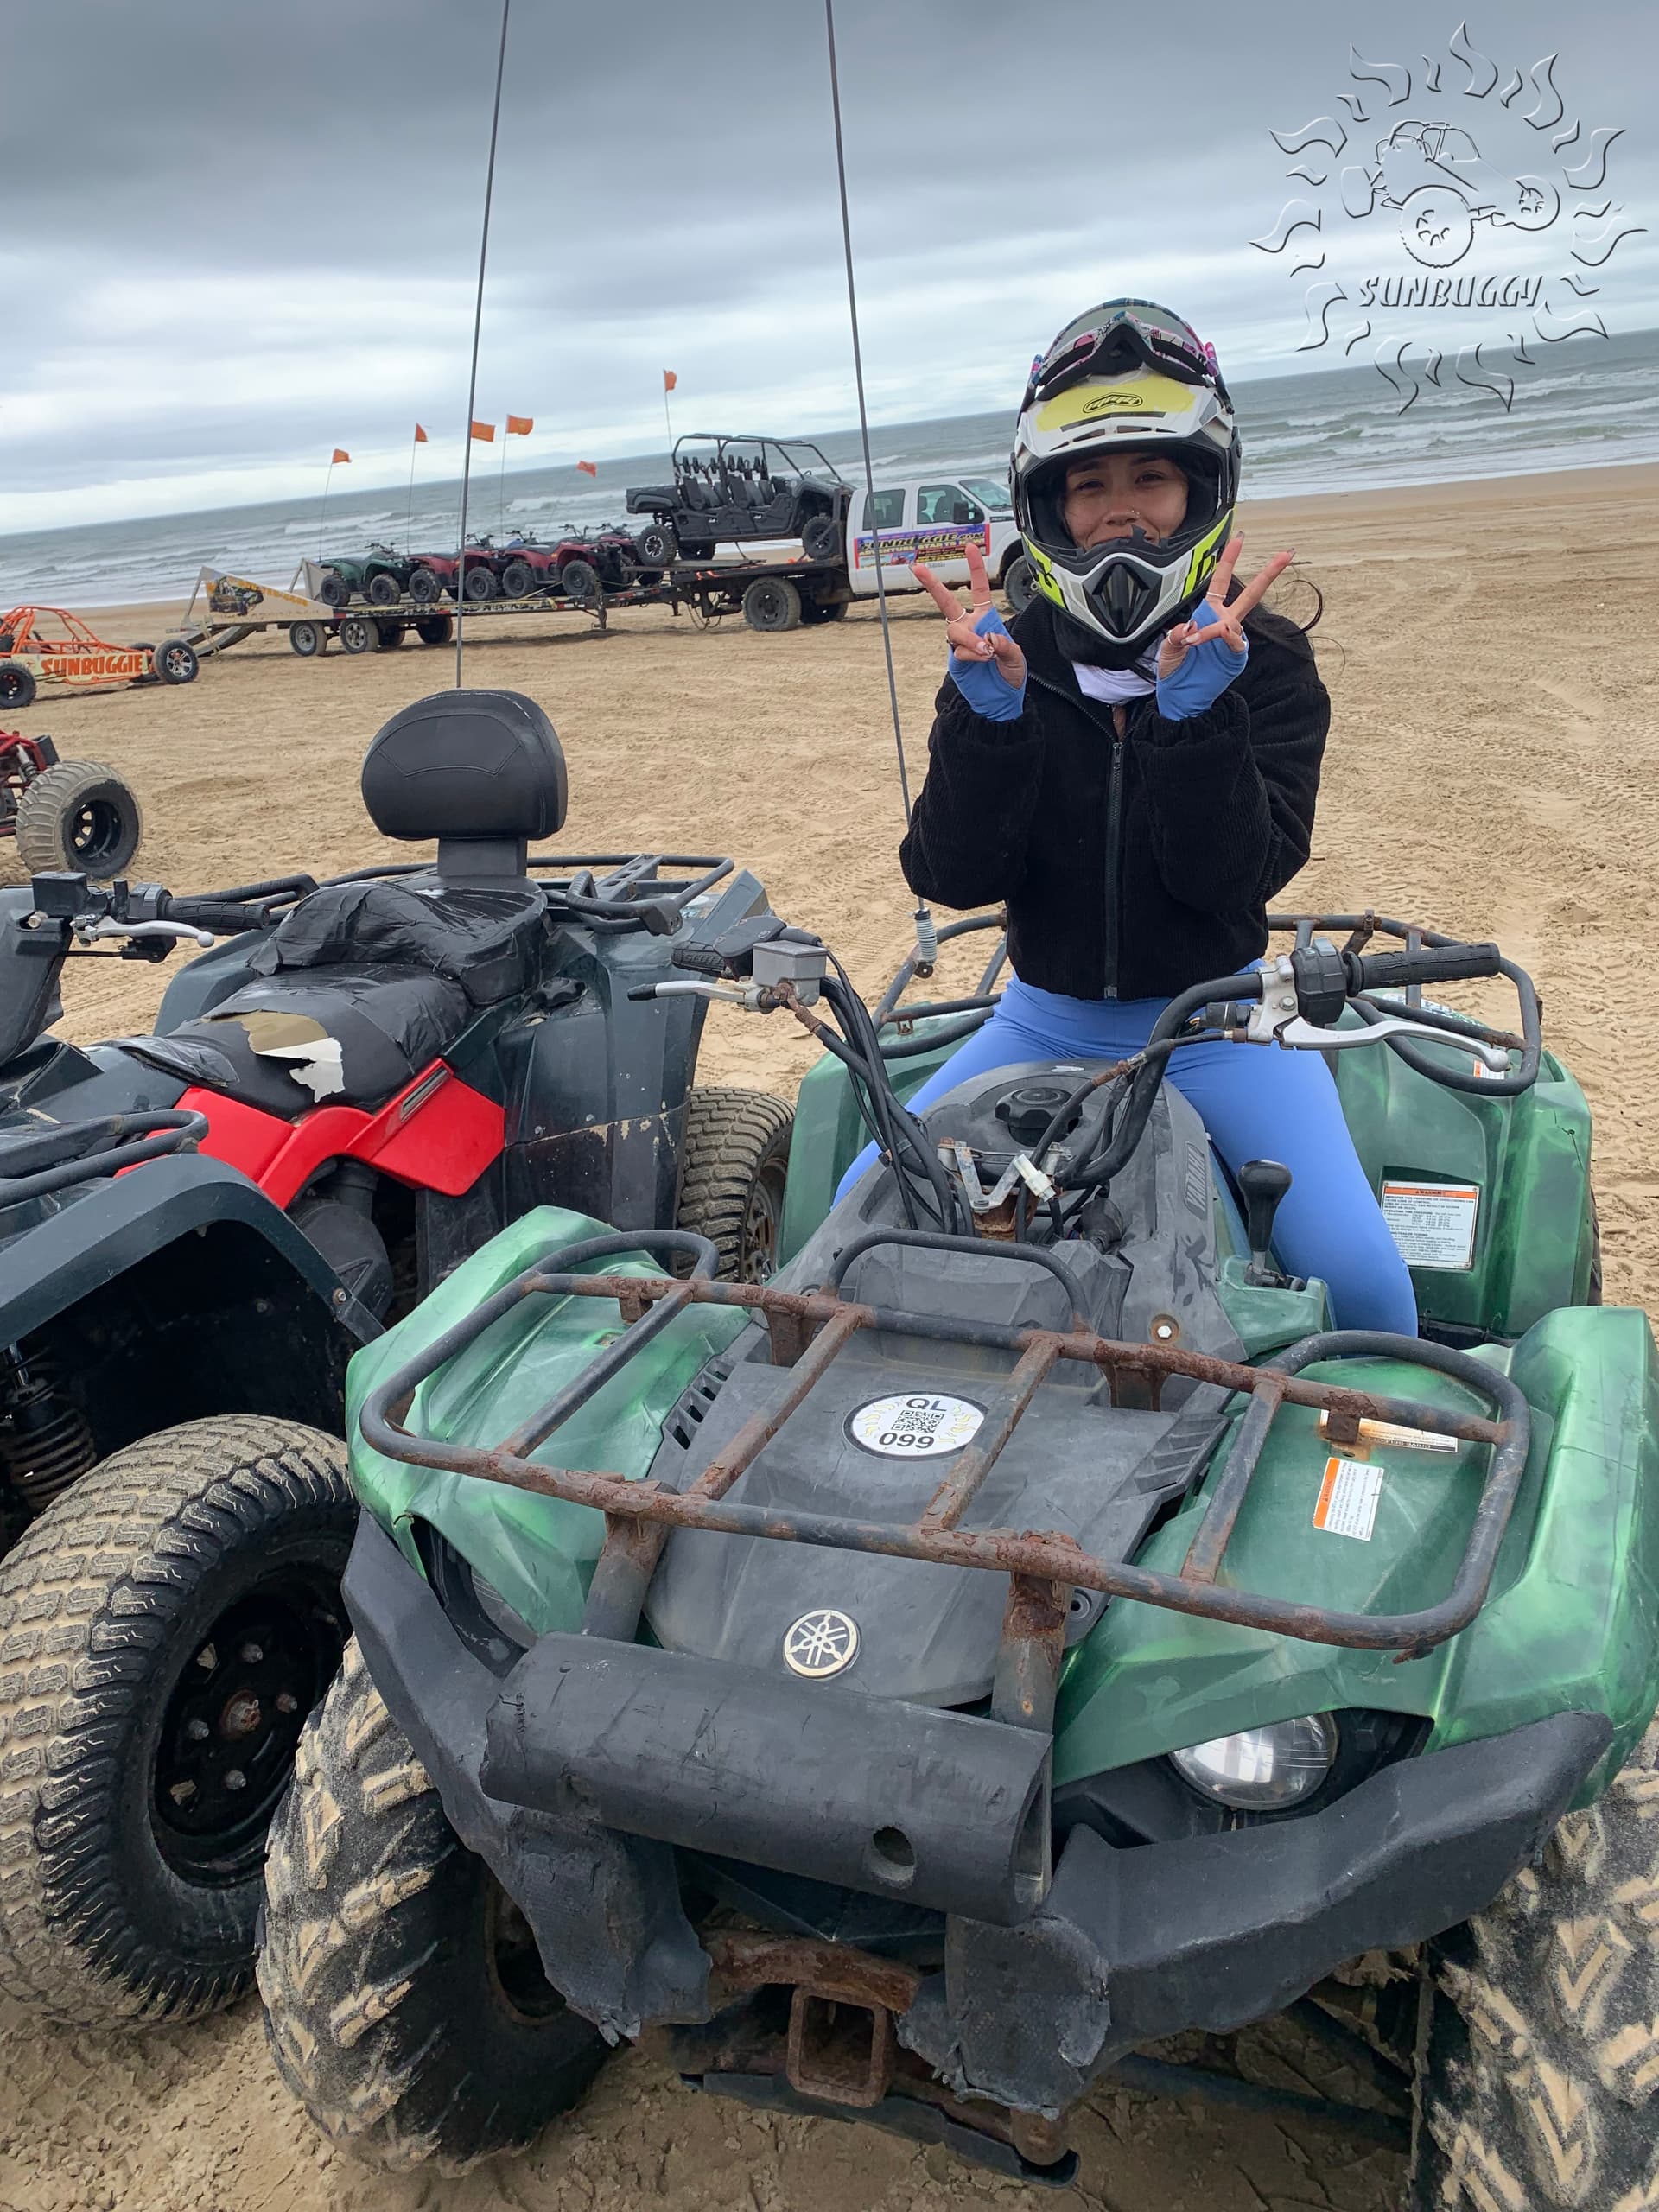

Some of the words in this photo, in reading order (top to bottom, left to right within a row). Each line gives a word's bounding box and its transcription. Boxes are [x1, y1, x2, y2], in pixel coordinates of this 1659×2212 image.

[918, 540, 957, 550] STARTS
[41, 654, 143, 677] SUNBUGGIE
[1187, 1145, 1206, 1211] YAMAHA
[906, 1398, 947, 1412] QL
[879, 1432, 935, 1449] 099
